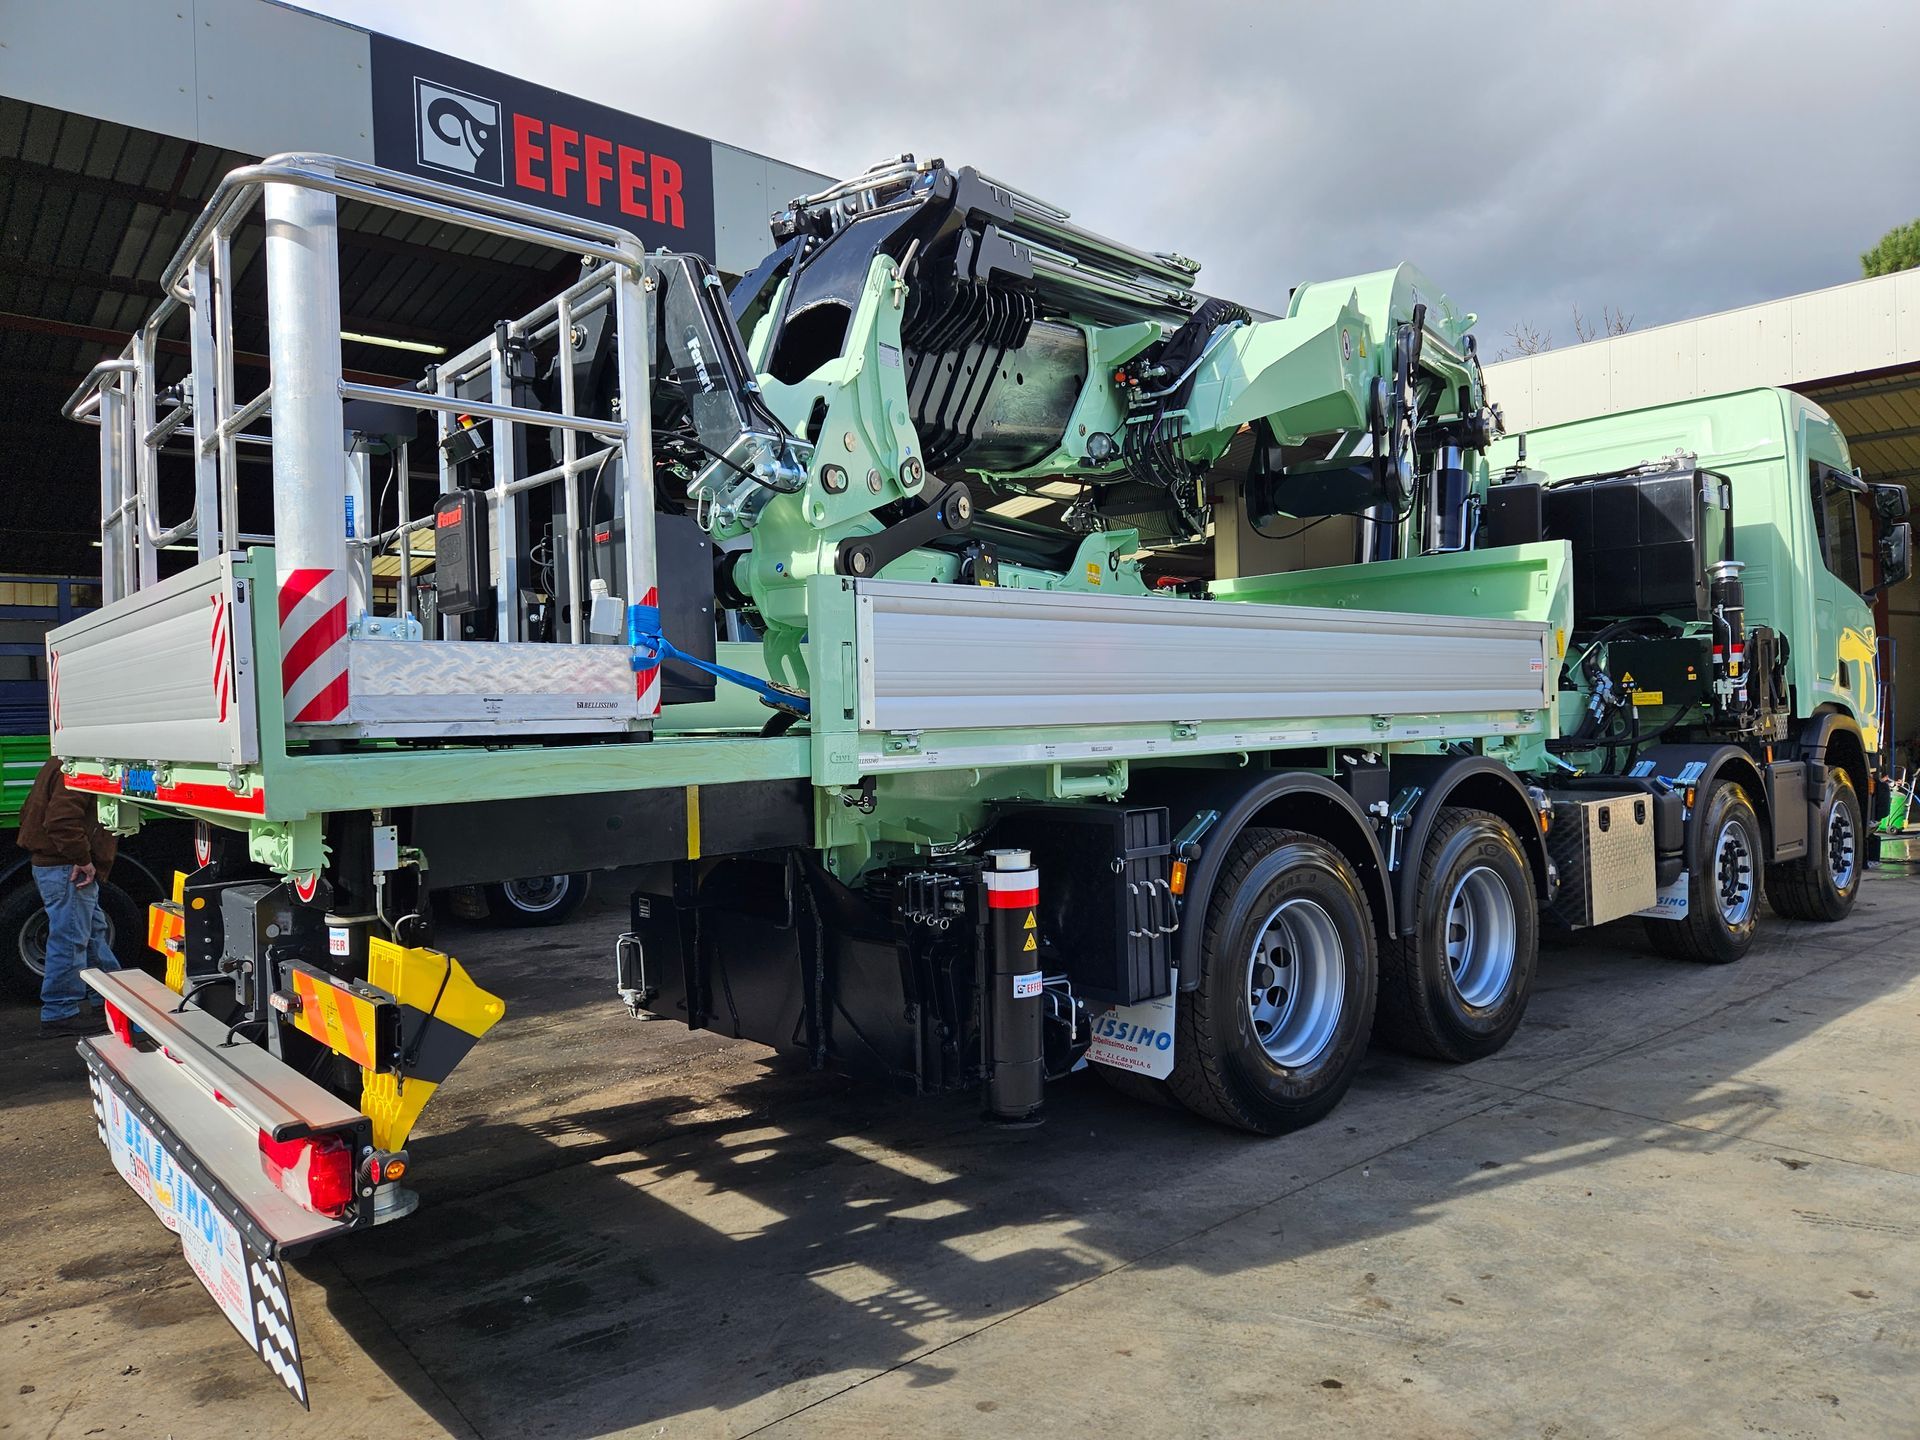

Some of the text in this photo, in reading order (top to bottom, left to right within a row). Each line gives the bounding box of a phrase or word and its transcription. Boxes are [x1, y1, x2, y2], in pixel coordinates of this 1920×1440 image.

[513, 112, 685, 229] EFFER
[687, 336, 715, 394] Ferrari
[1656, 897, 1688, 907] SIMO
[1091, 1017, 1172, 1051] ISSIMO
